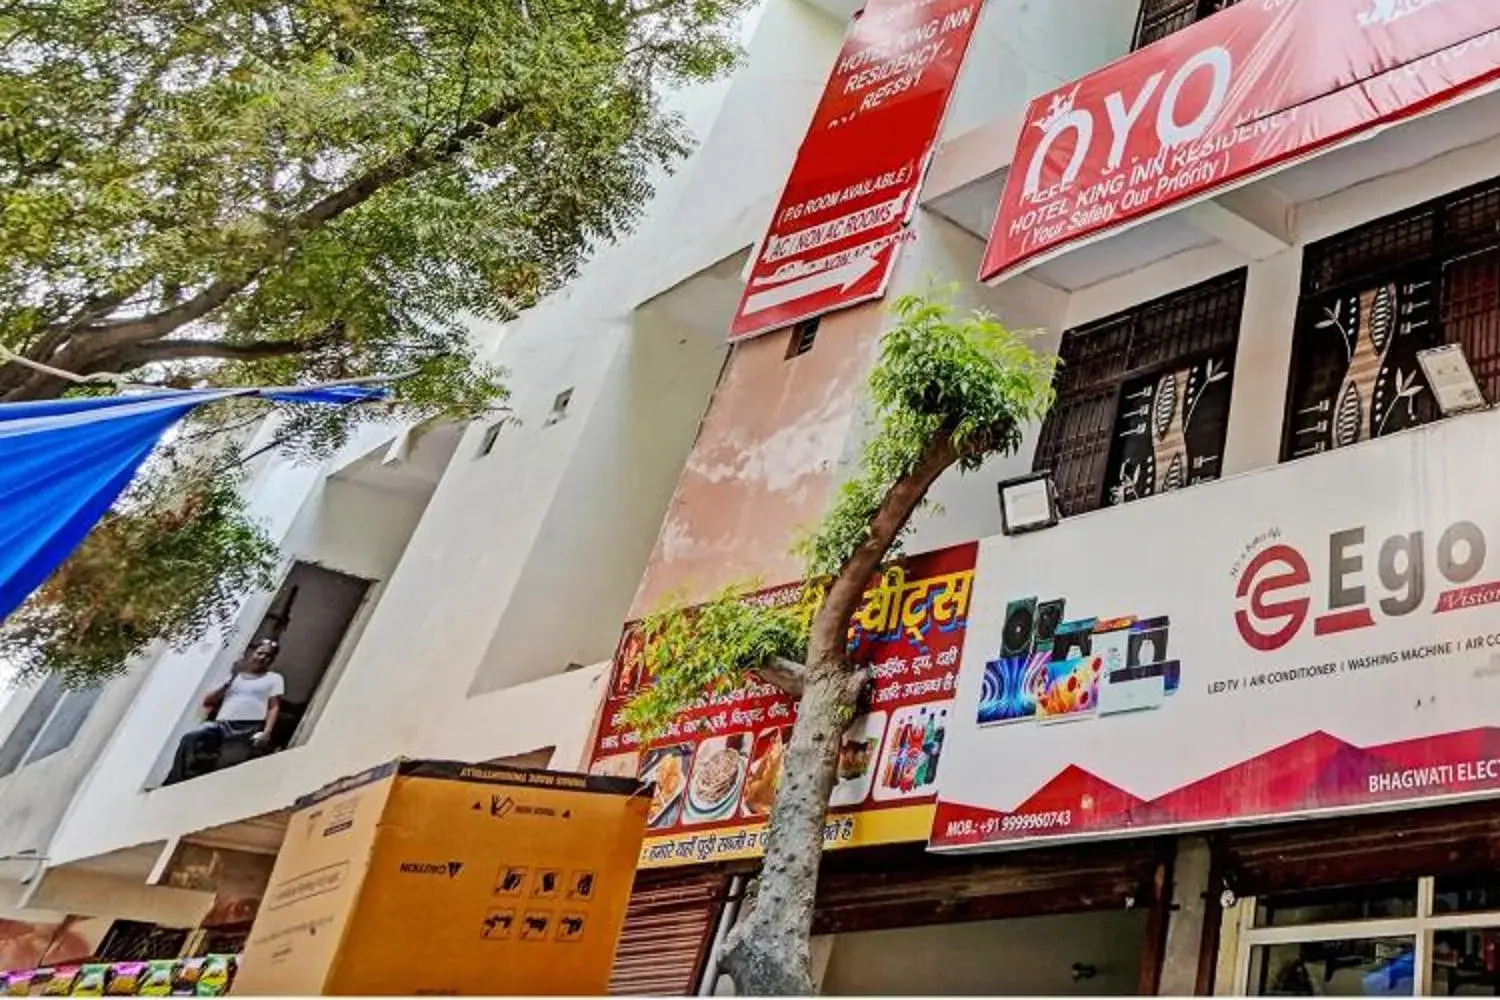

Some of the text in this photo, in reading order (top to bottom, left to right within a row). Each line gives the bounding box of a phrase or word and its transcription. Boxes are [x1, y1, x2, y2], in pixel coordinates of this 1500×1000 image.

[842, 38, 946, 95] RESIDENCY
[803, 192, 840, 217] ROOM
[1008, 194, 1070, 238] HOTEL
[1075, 173, 1127, 210] KING
[1129, 155, 1166, 189] INN
[1121, 185, 1153, 212] Our
[796, 229, 824, 251] NON
[823, 224, 846, 245] AC
[845, 203, 894, 233] ROOMS
[1327, 519, 1487, 617] Ego
[1207, 680, 1227, 695] LED
[1249, 672, 1266, 689] AIR
[1266, 662, 1338, 687] CONDITIONER
[1347, 651, 1399, 673] WASHING
[1400, 640, 1453, 663] MACHINE
[1465, 634, 1486, 652] AIR
[1368, 764, 1455, 794] BHAGWATI
